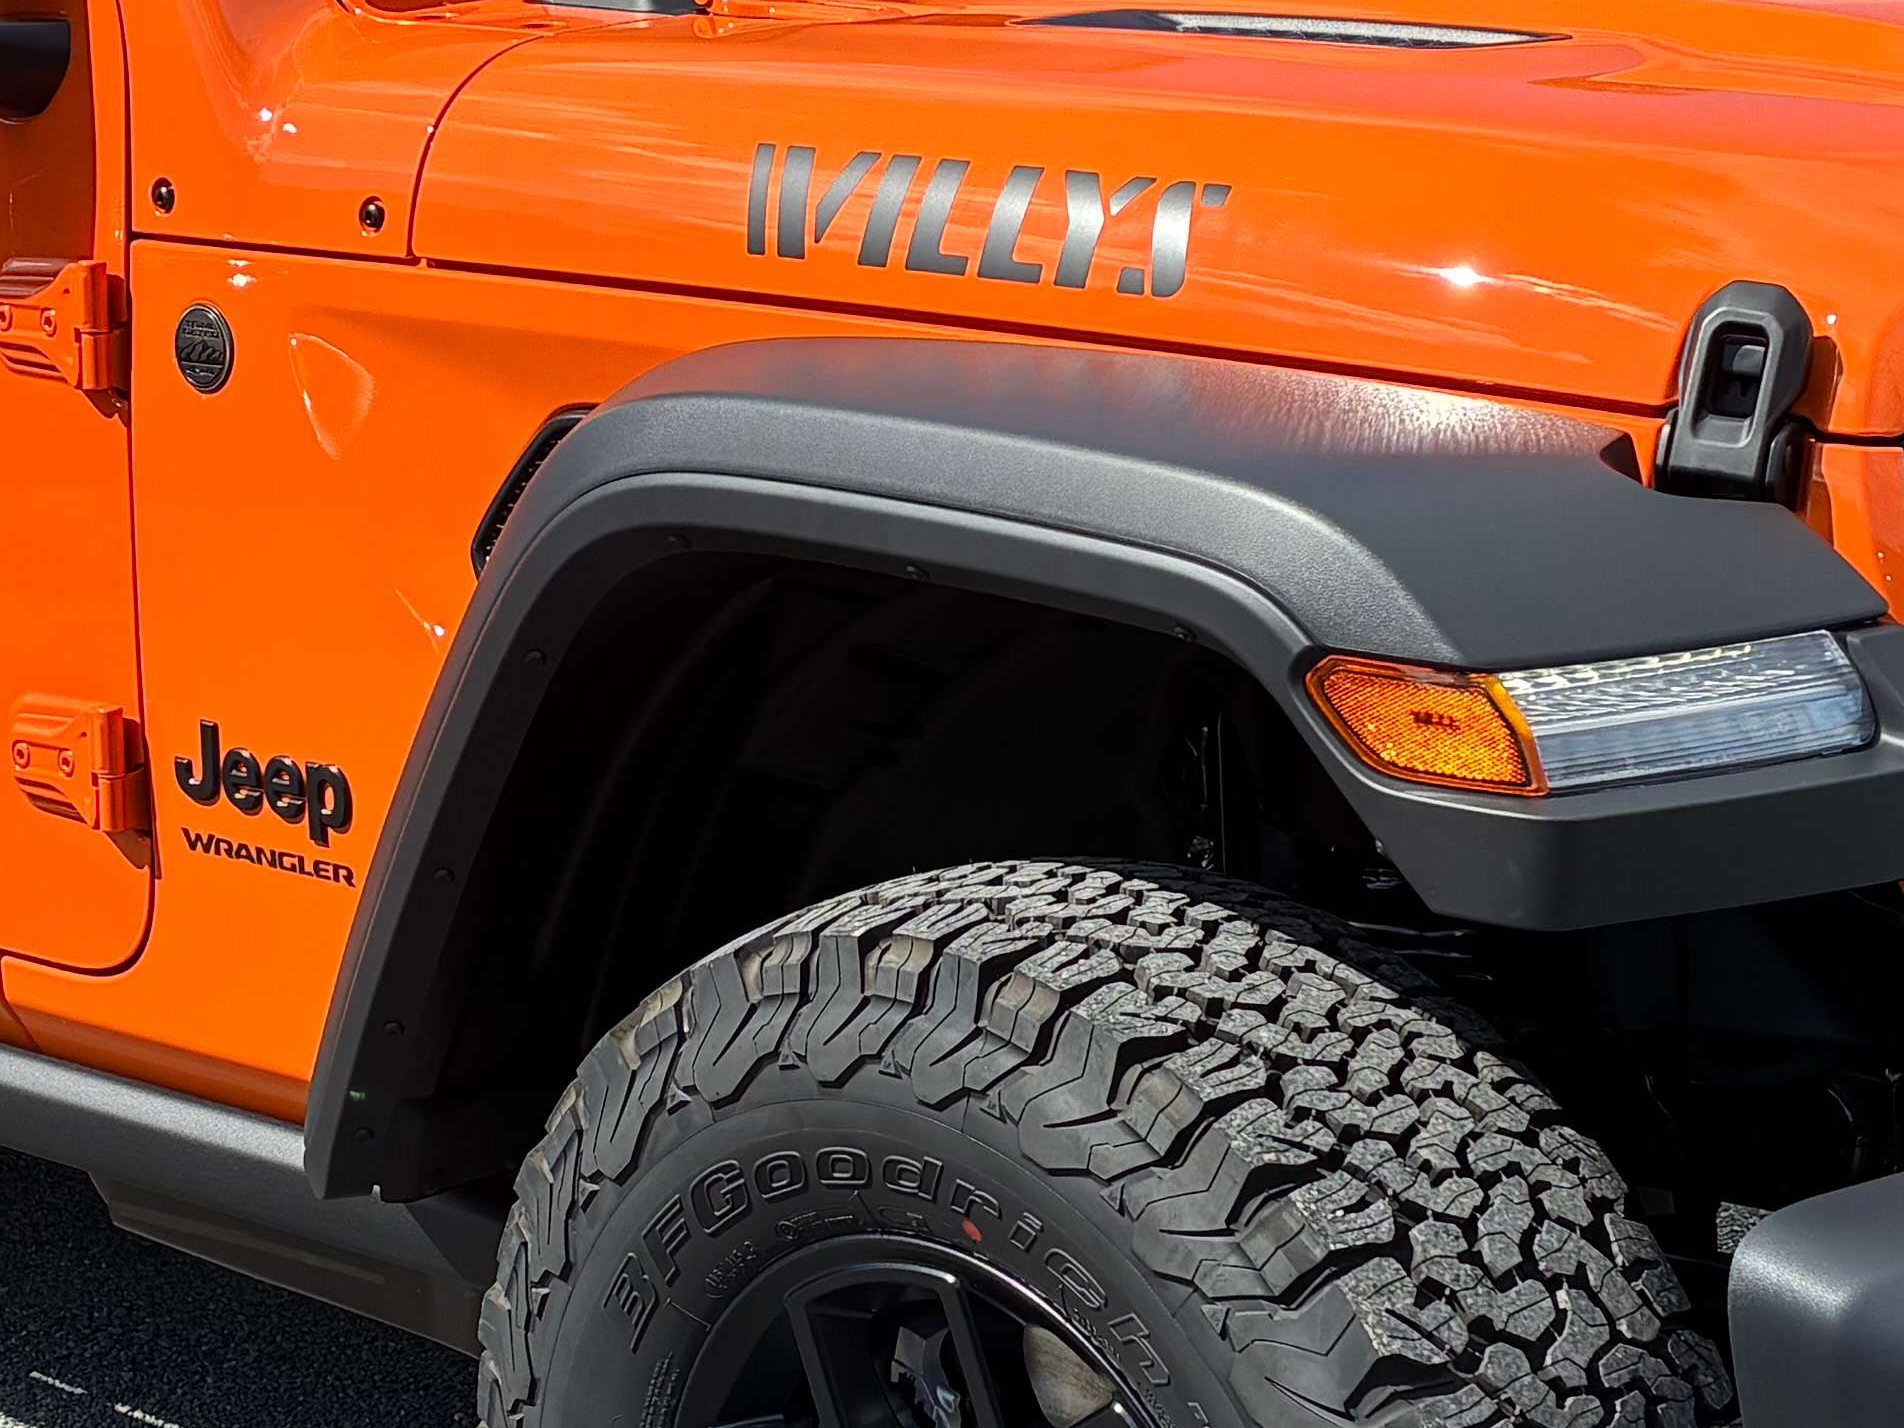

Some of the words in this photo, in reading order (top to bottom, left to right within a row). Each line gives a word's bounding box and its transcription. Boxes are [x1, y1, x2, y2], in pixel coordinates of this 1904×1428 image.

[747, 143, 1233, 298] WILLYS
[175, 719, 353, 848] Jeep
[181, 827, 356, 888] WRANGLER
[602, 1146, 1169, 1386] BFGoodrich
